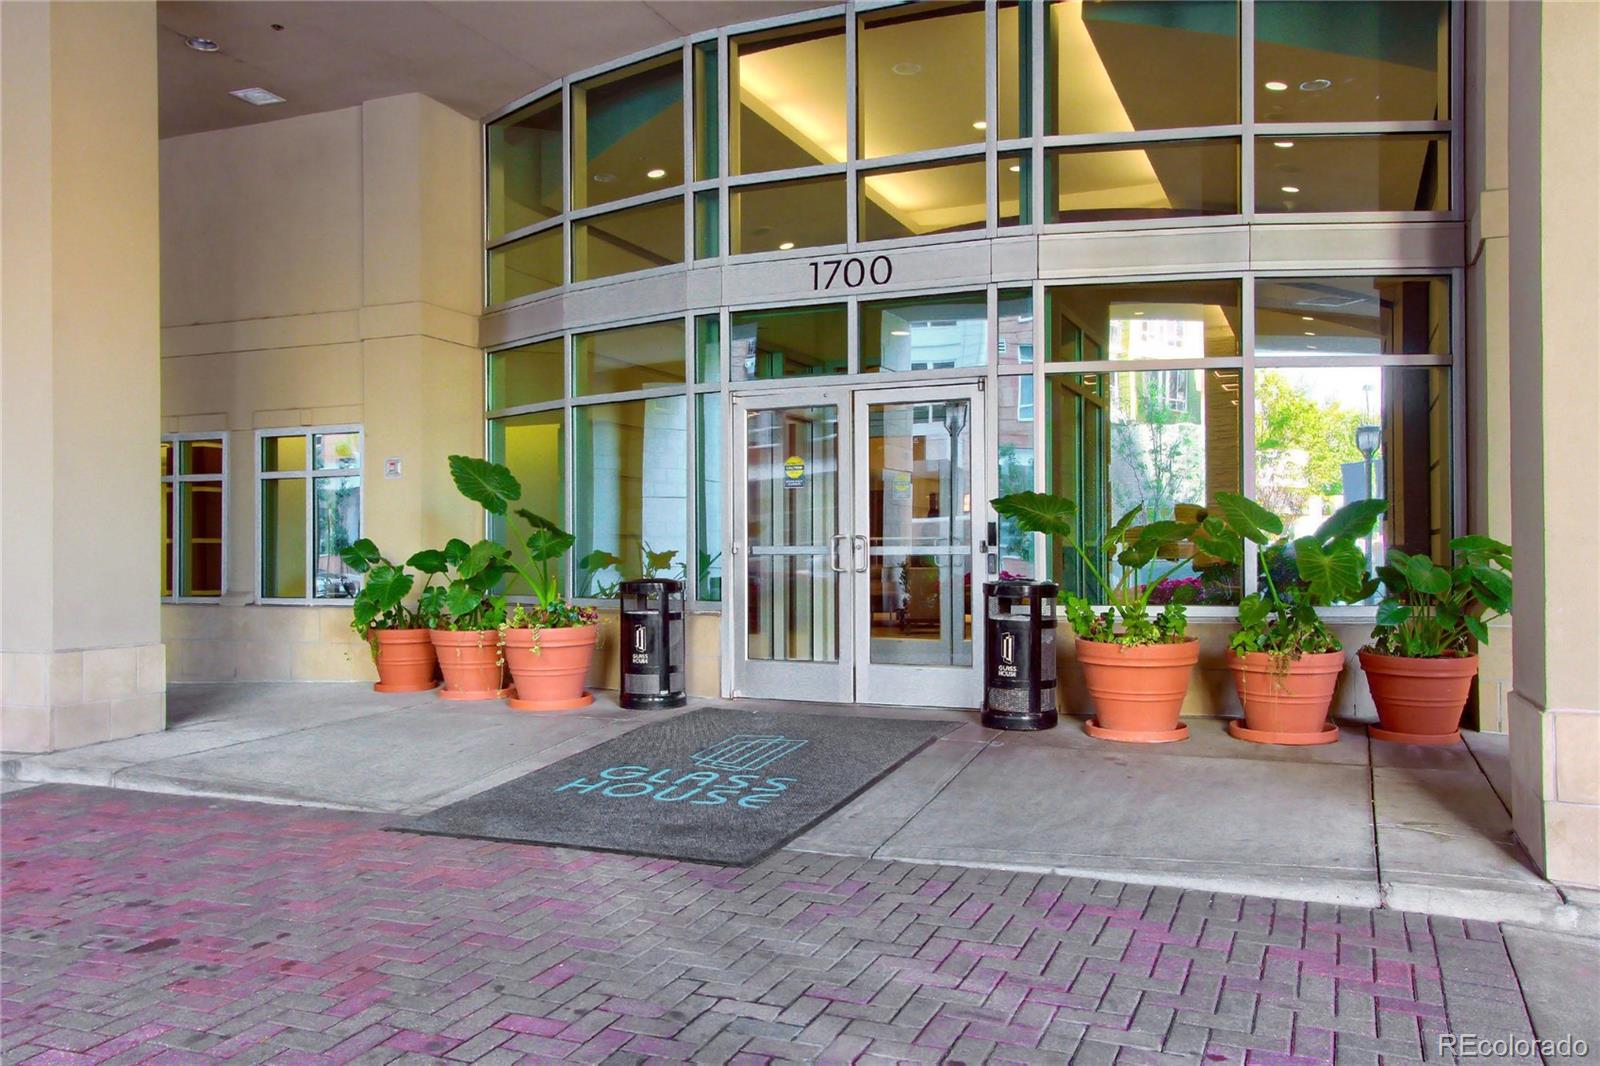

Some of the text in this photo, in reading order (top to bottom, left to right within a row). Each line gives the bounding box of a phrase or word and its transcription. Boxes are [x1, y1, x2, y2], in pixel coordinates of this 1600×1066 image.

[808, 255, 893, 290] 1700
[554, 777, 780, 809] HOUSE
[600, 765, 797, 791] GLASS
